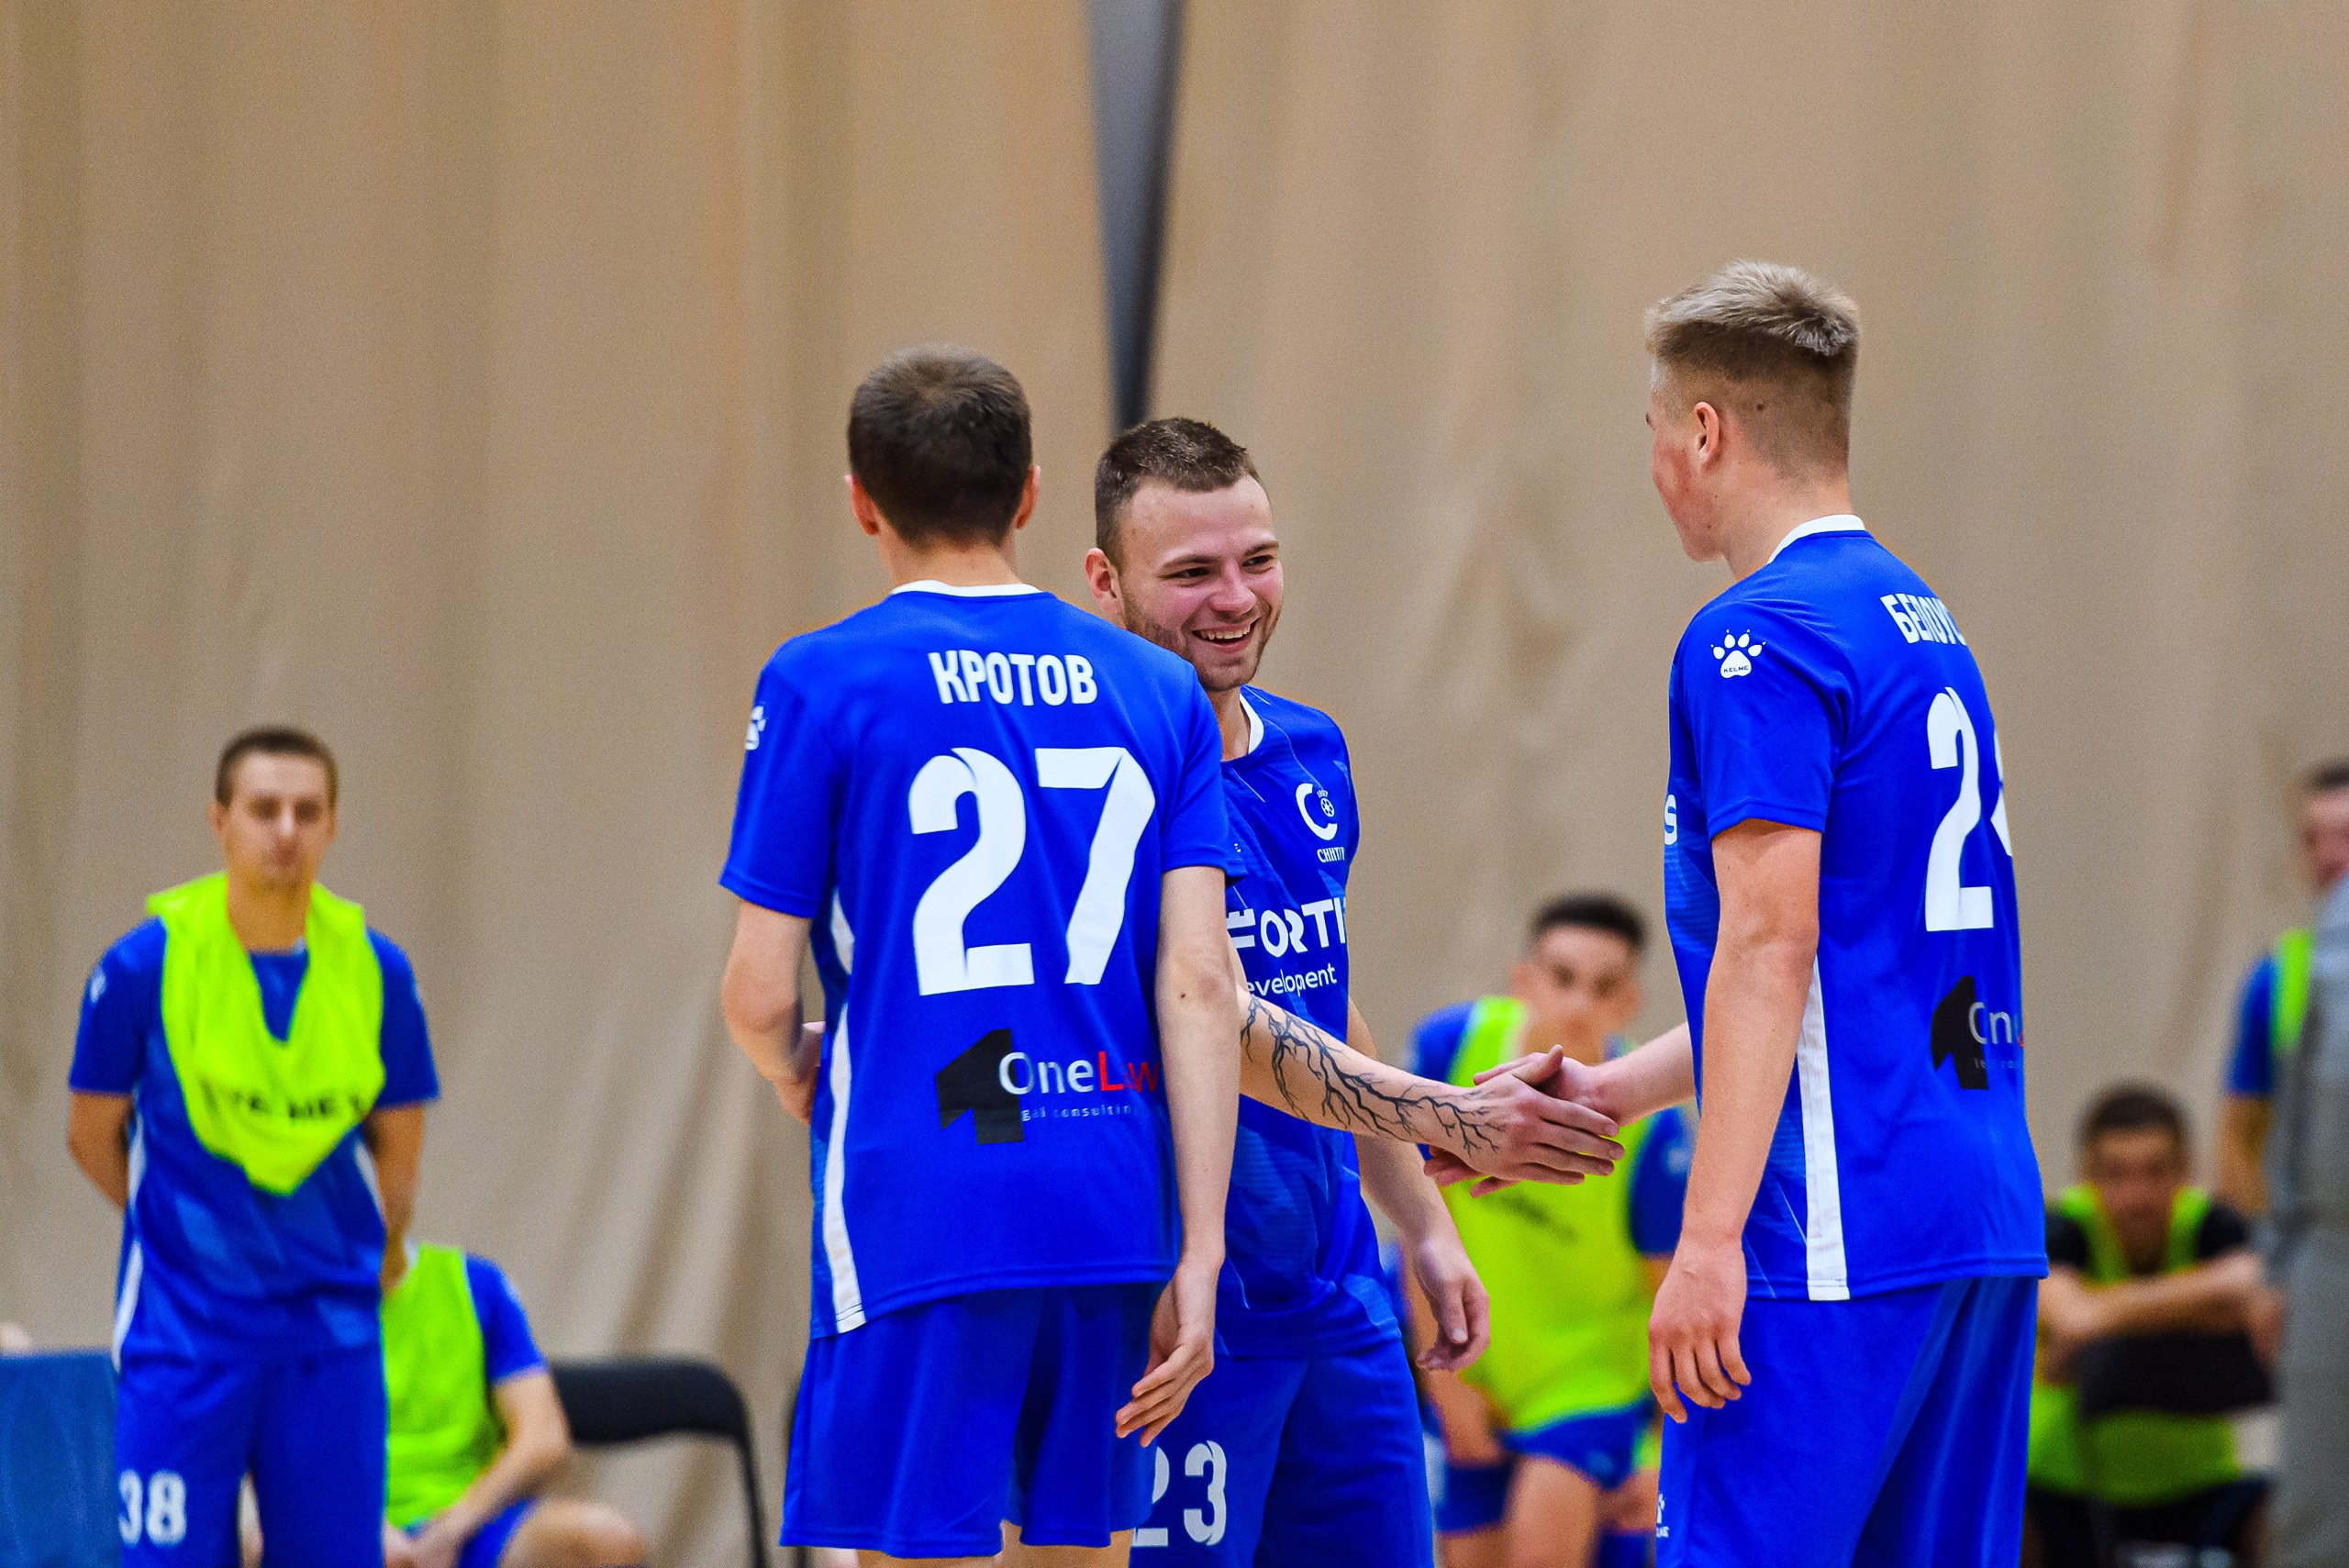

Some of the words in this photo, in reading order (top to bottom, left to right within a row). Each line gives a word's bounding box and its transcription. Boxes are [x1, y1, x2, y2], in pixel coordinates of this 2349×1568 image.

[928, 650, 1097, 706] КРОТОВ
[1927, 686, 2011, 930] 2
[907, 747, 1155, 995] 27
[1227, 897, 1346, 957] FORTI
[118, 1469, 186, 1546] 38
